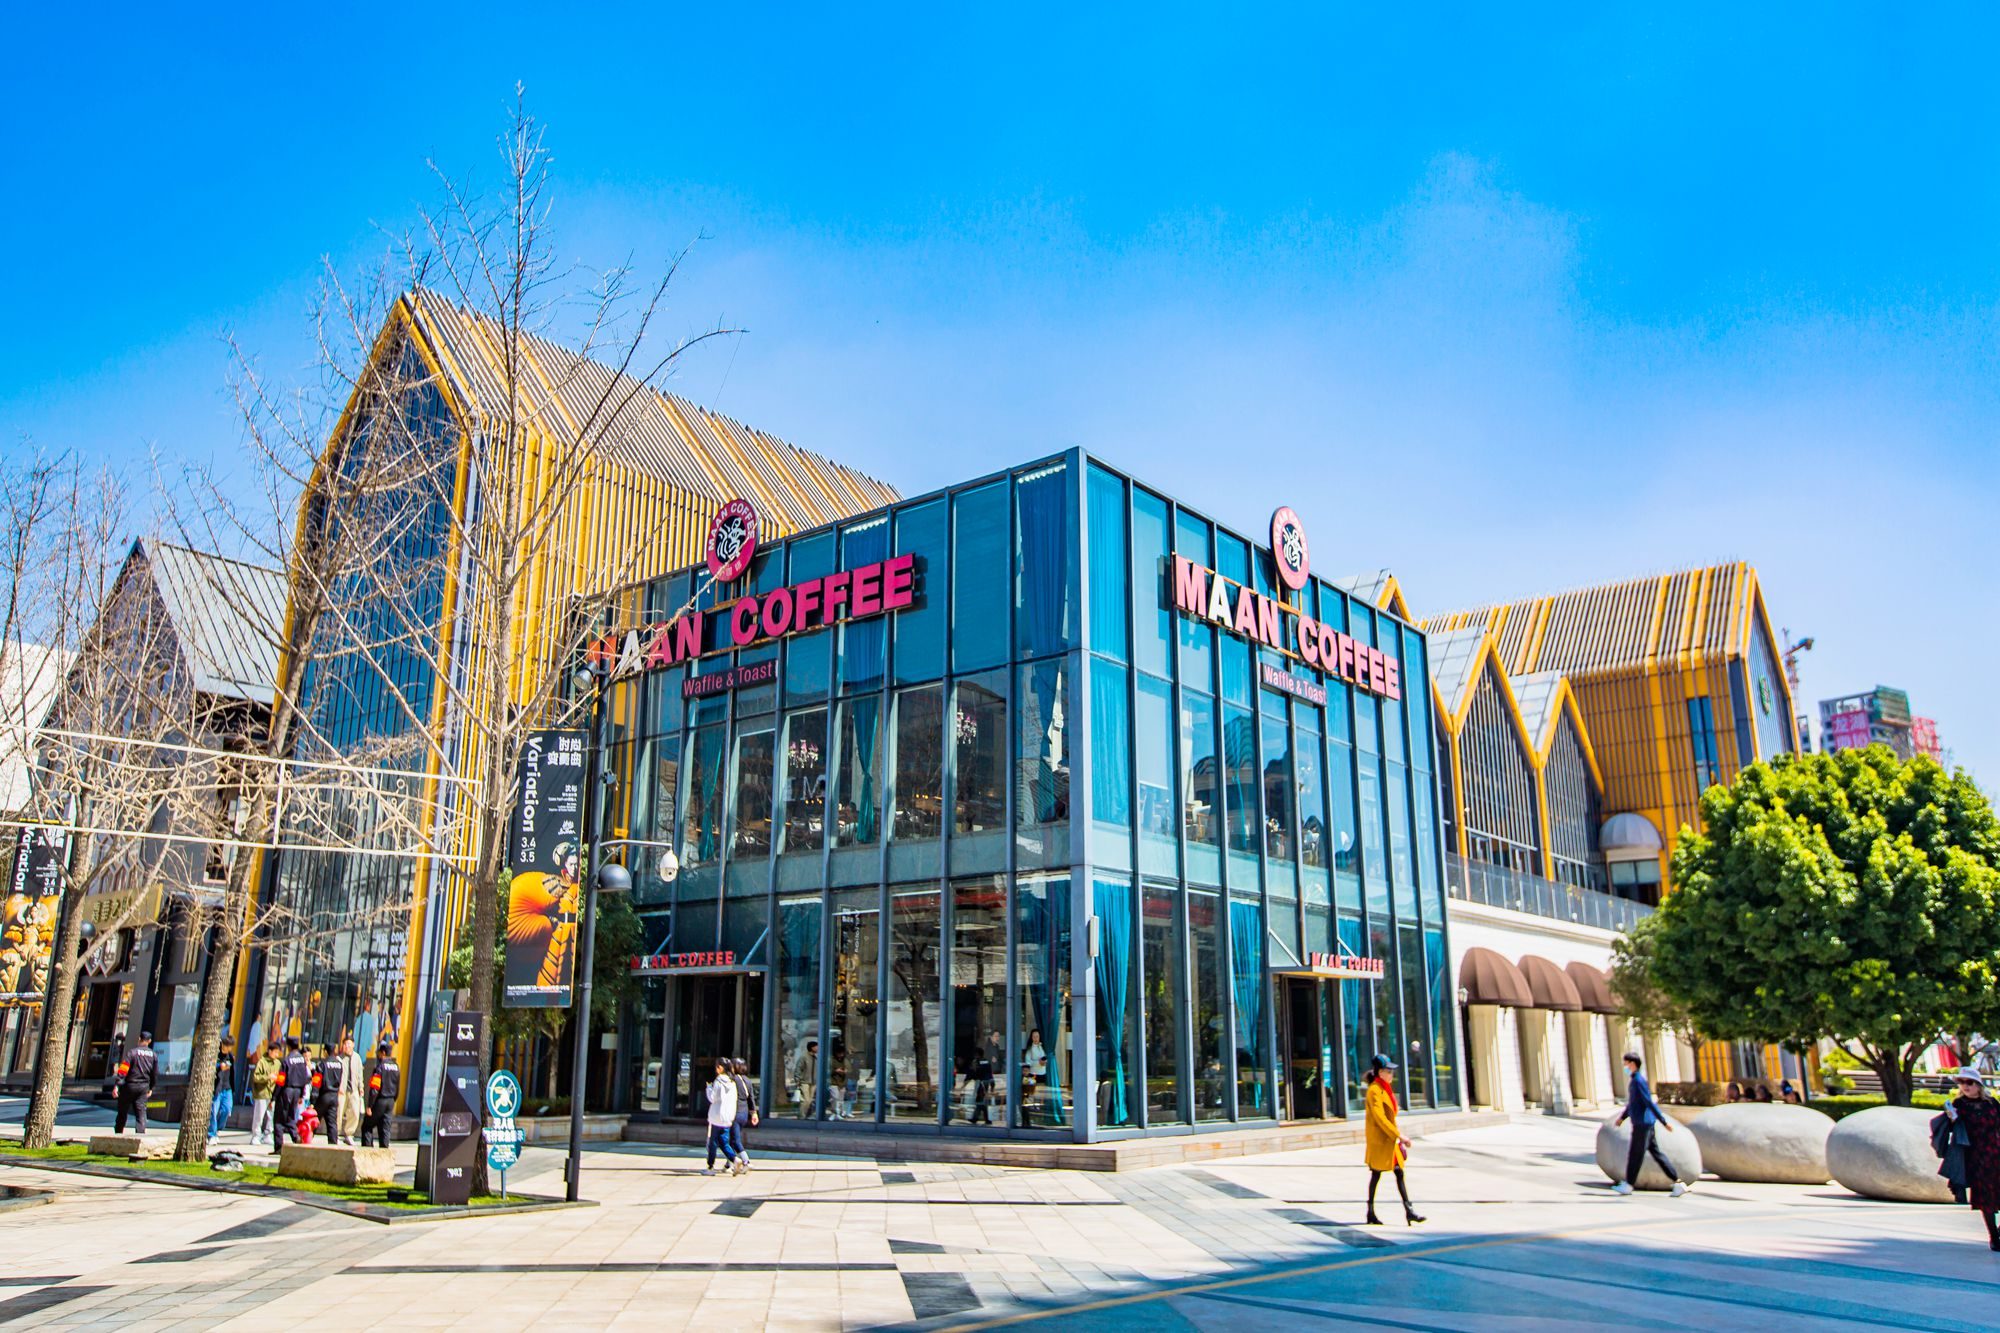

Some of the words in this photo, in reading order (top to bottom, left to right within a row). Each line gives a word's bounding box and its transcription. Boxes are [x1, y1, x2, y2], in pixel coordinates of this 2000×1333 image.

[731, 553, 914, 646] COFFEE
[1173, 553, 1280, 648] MAAN
[1297, 615, 1400, 701] COFFEE
[683, 673, 723, 698] Waffle
[725, 671, 734, 688] &
[737, 659, 773, 685] Toast
[1264, 664, 1295, 691] Waffle
[1295, 679, 1302, 696] &
[1303, 679, 1326, 704] Toast
[522, 736, 543, 832] Variation
[15, 826, 36, 890] Variation
[520, 851, 536, 863] 3.5
[521, 836, 536, 849] 3.4
[630, 955, 669, 970] MAAN
[678, 951, 735, 967] COFFEE
[1311, 951, 1342, 969] MAAN
[1347, 956, 1384, 973] COFFEE
